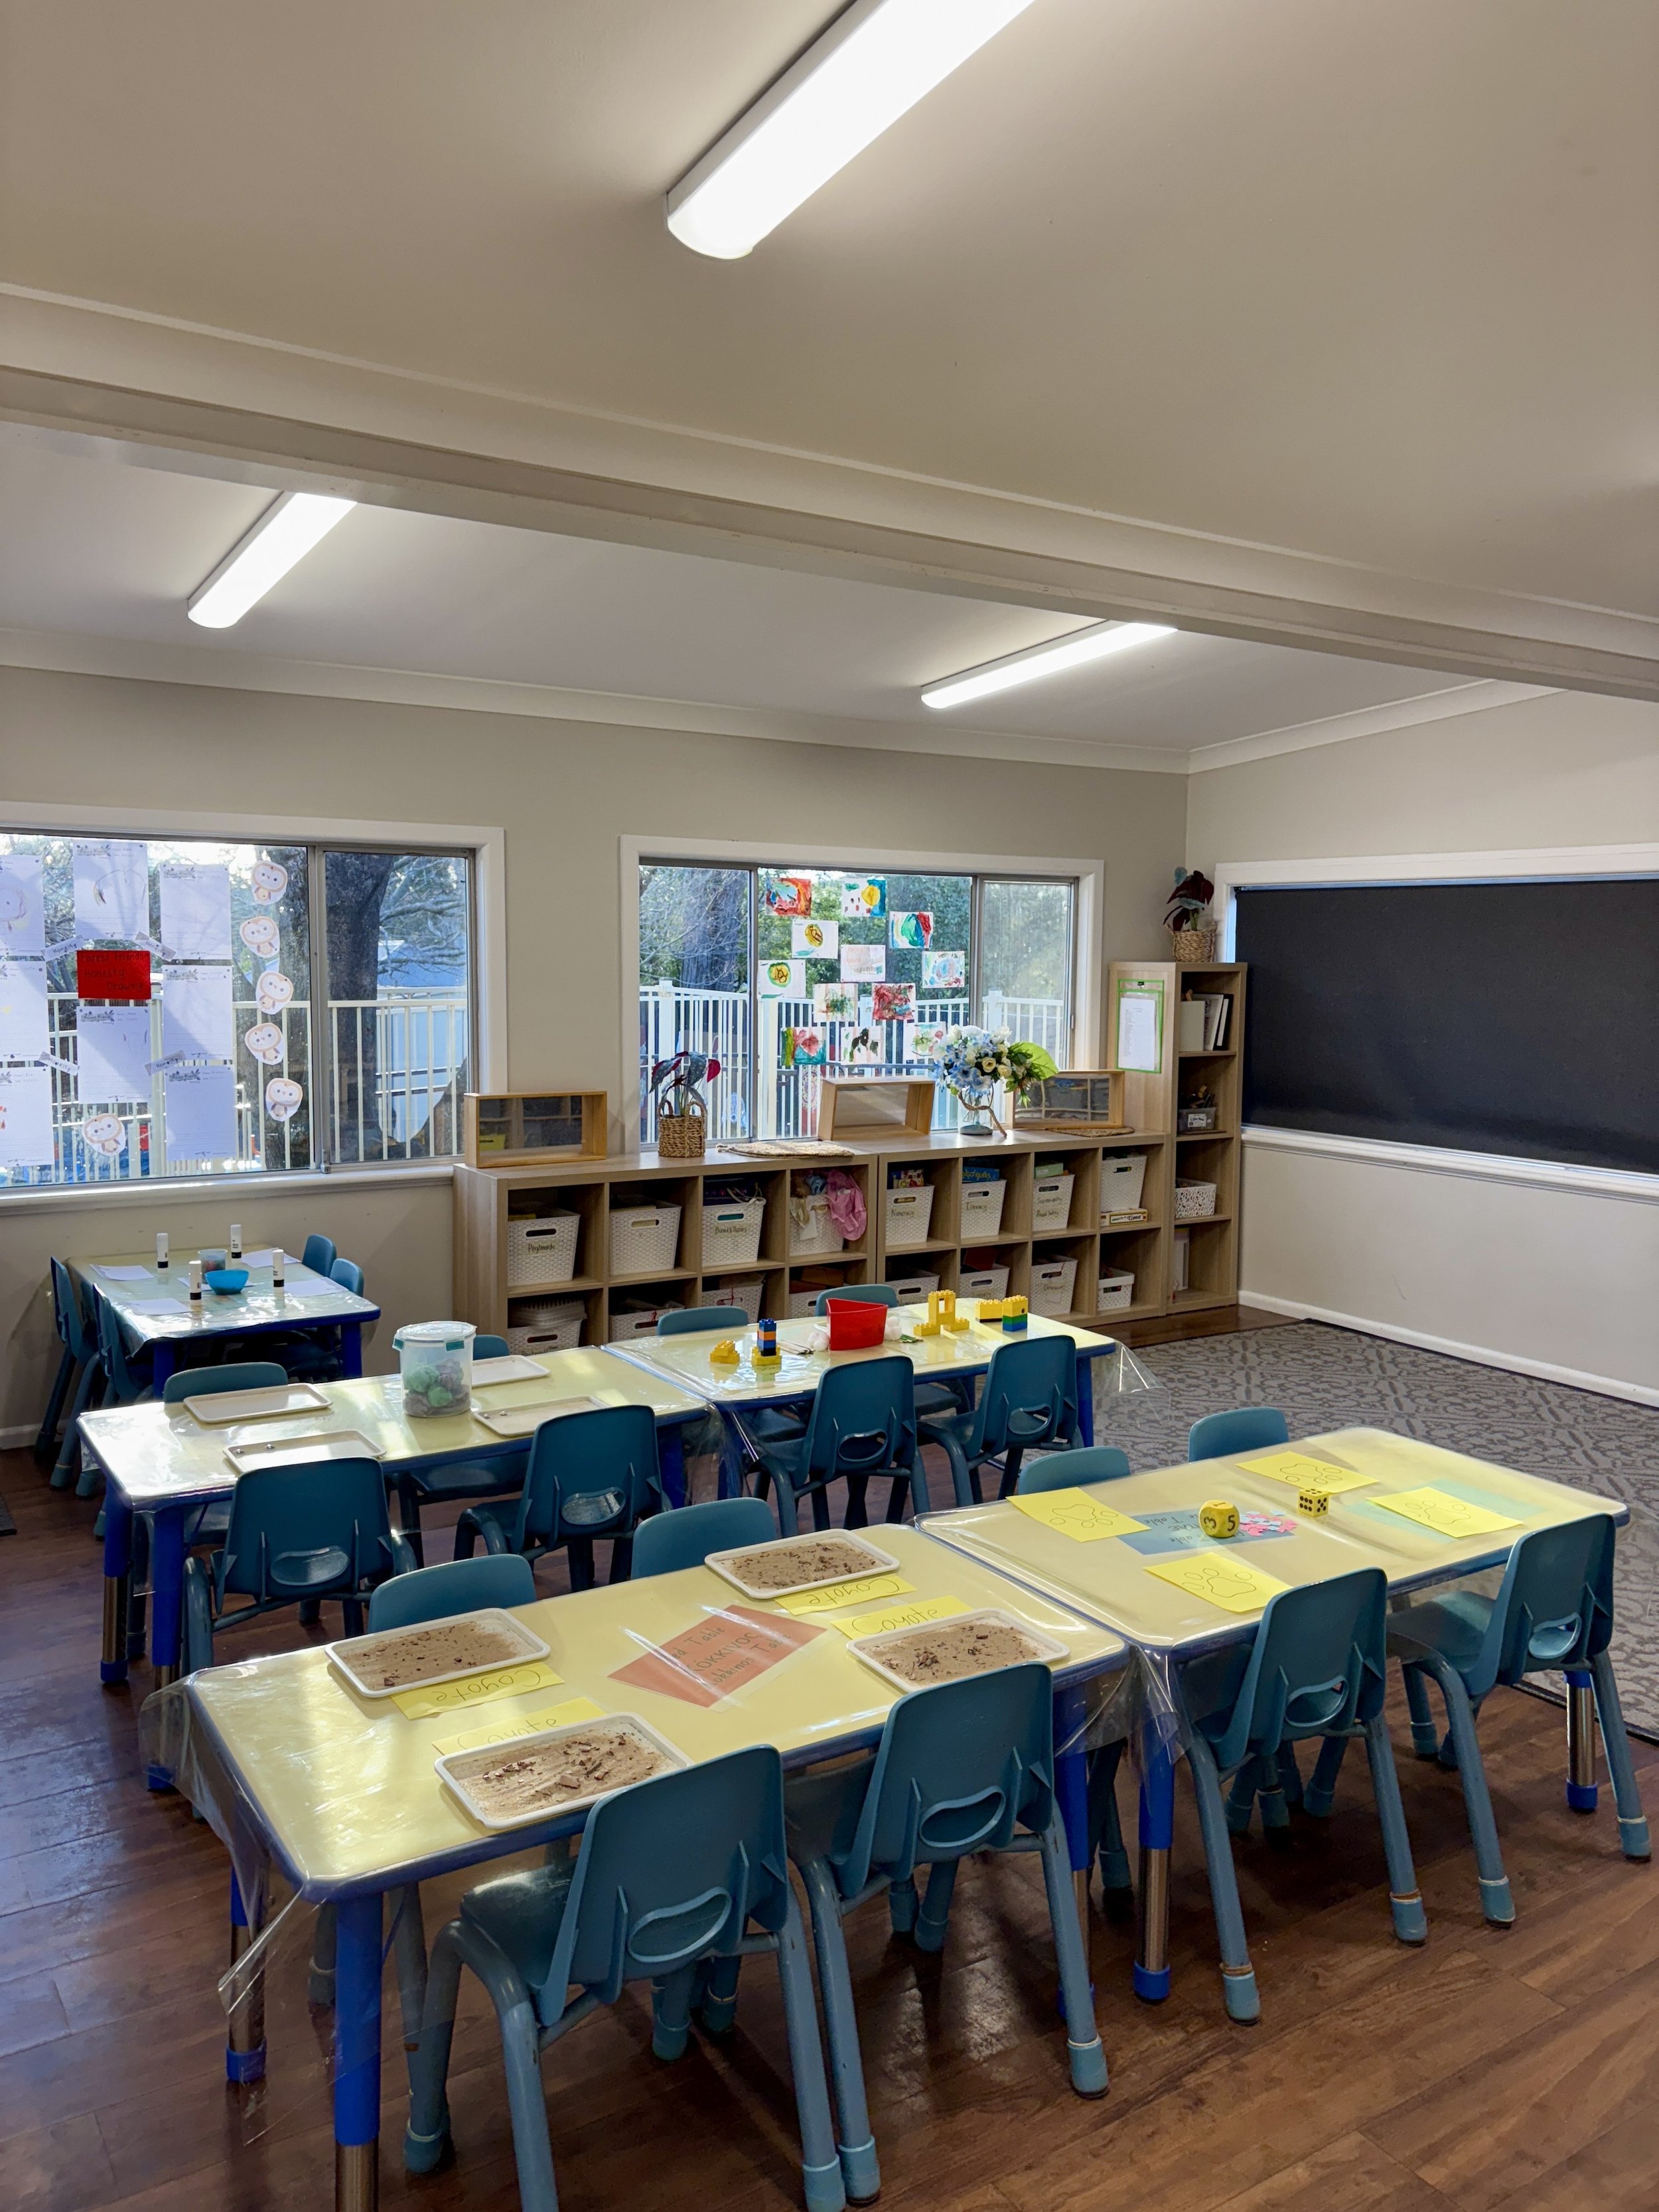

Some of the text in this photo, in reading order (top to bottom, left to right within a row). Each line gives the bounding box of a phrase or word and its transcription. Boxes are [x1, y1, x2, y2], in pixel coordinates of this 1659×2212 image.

[1203, 1515, 1217, 1530] 3
[1227, 1514, 1236, 1532] 5
[806, 1578, 900, 1605] Coyote
[851, 1607, 938, 1635] Coyote
[684, 1627, 725, 1646] Table
[436, 1668, 541, 1702] Coyote
